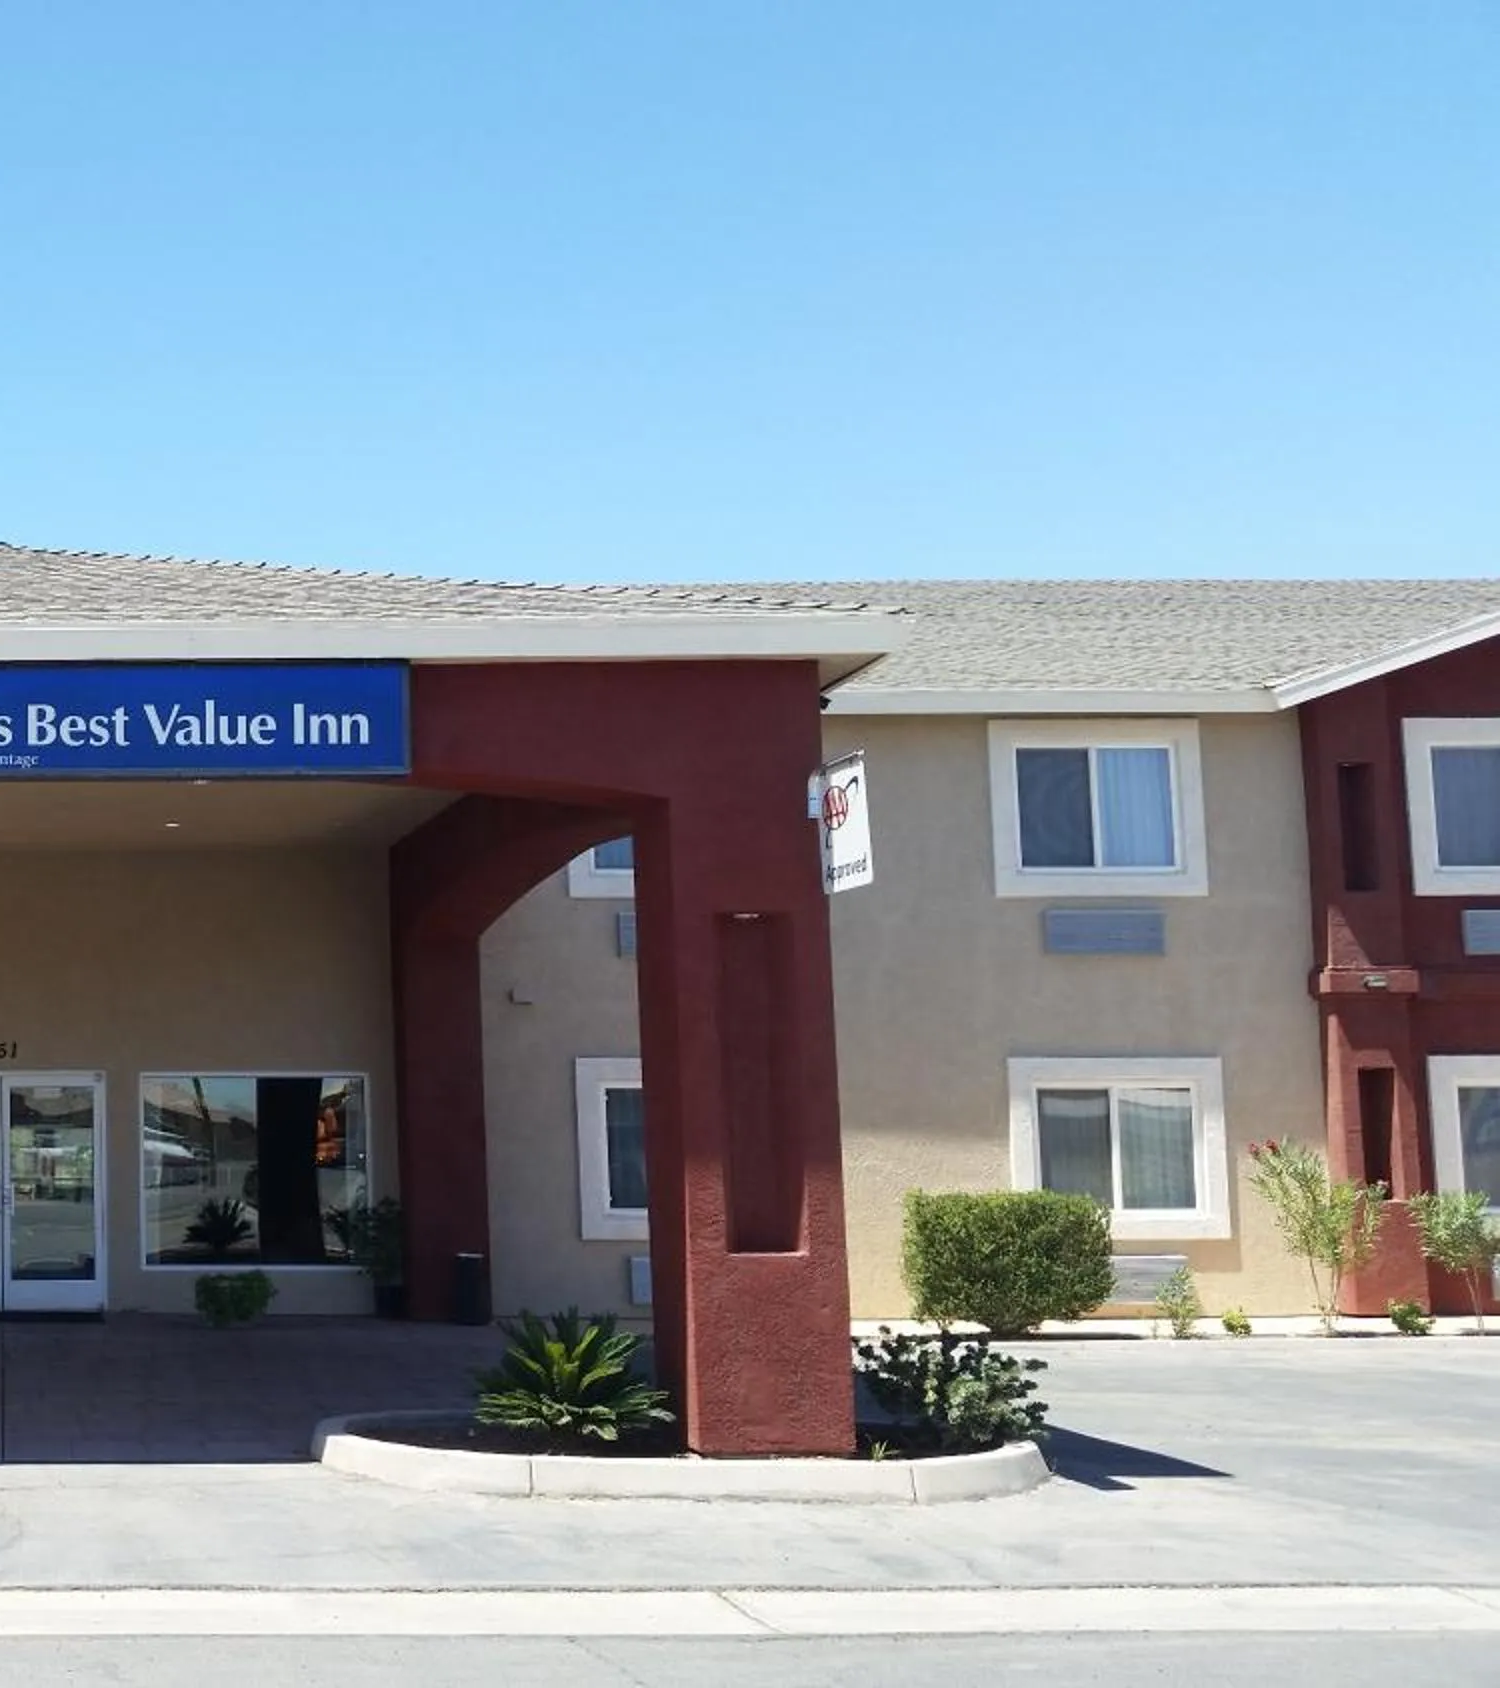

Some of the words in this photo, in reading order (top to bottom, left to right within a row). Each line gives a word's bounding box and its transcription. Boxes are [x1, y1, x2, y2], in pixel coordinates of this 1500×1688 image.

[27, 703, 130, 747] Best
[143, 699, 277, 746] Value
[293, 703, 370, 745] Inn
[826, 851, 867, 886] Approved
